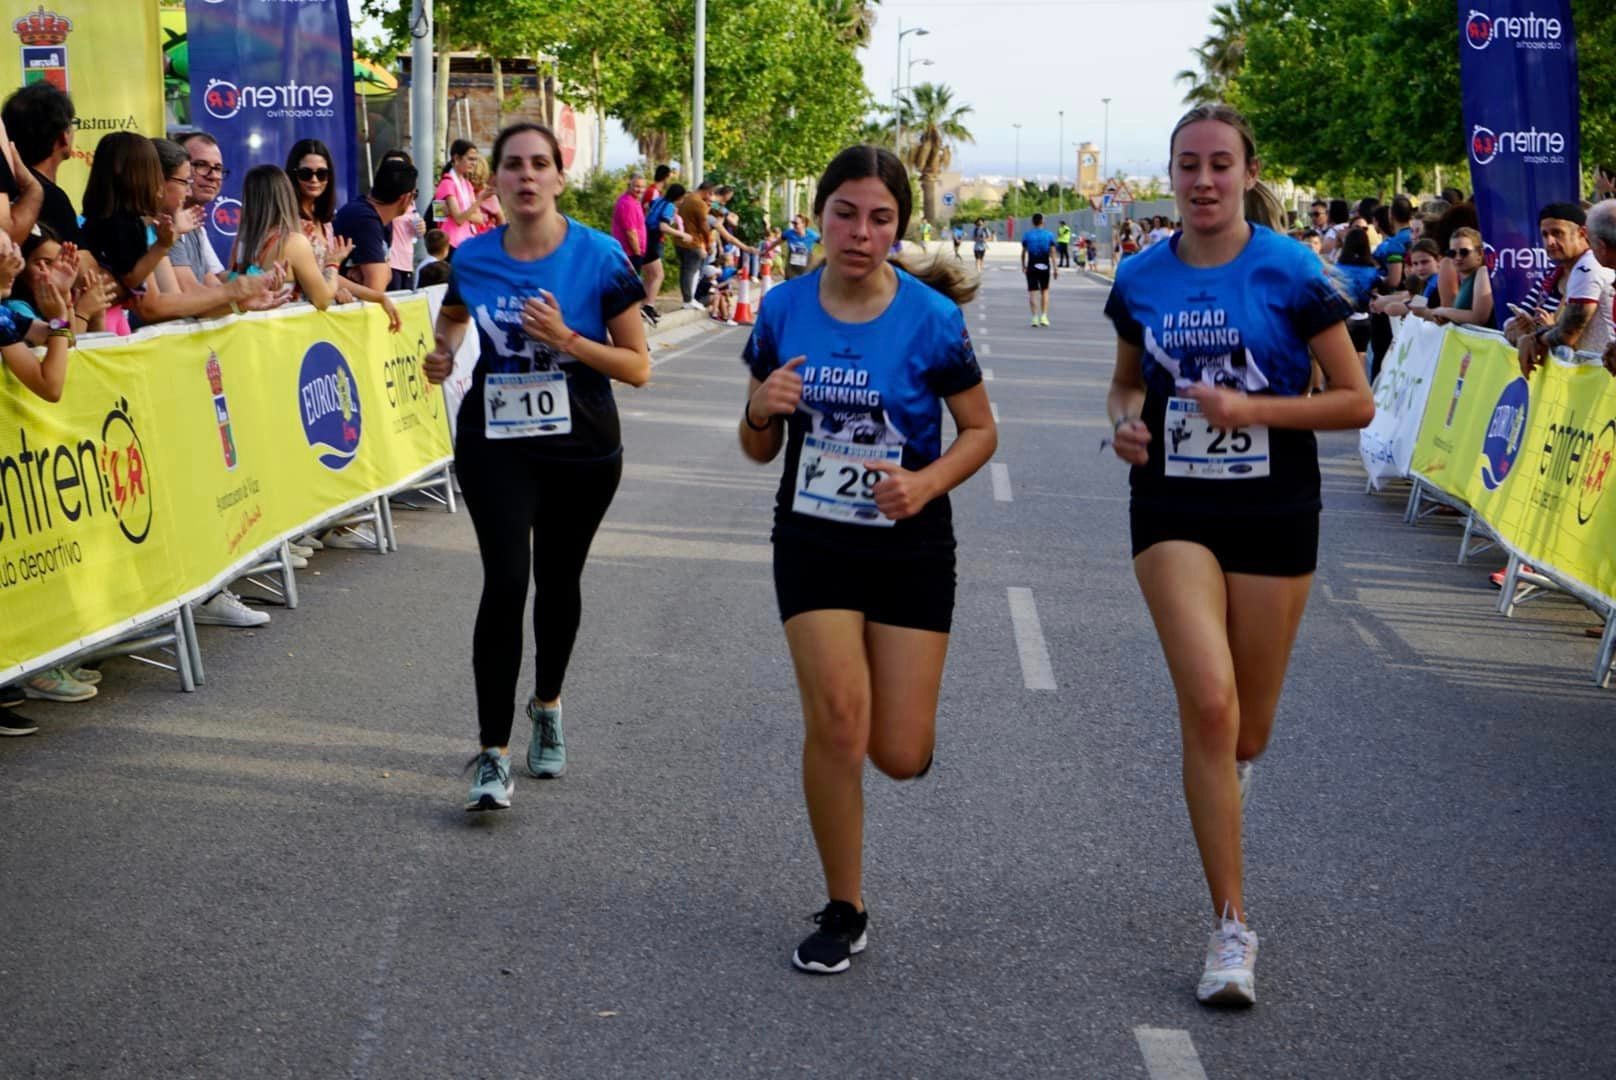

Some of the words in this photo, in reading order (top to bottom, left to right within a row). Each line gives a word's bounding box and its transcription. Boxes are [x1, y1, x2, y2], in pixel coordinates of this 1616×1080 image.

[1163, 313, 1173, 329] II
[1178, 309, 1225, 329] ROAD
[1162, 327, 1240, 349] RUNNING
[804, 366, 816, 383] II
[820, 366, 868, 387] ROAD
[520, 390, 554, 417] 10
[802, 384, 880, 408] RUNNING
[1207, 425, 1252, 454] 25
[0, 428, 107, 544] ntren
[836, 466, 881, 499] 29
[19, 536, 82, 584] deportivo
